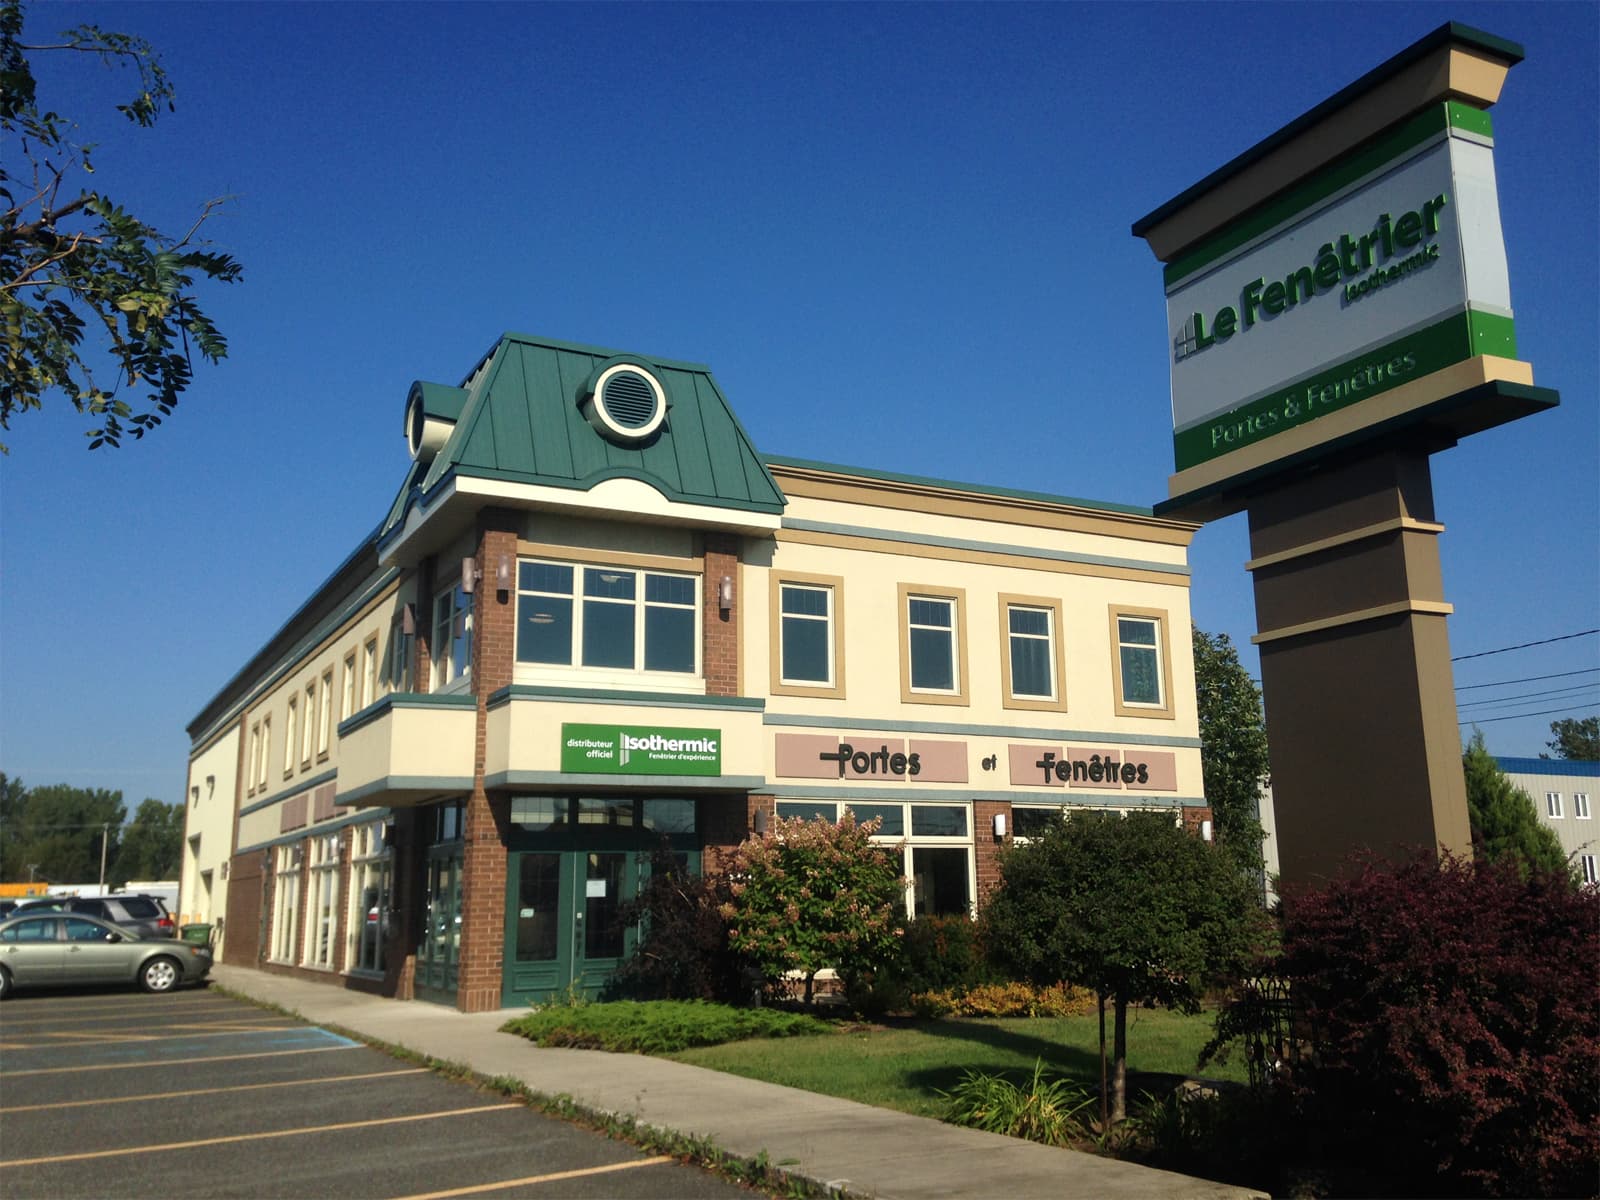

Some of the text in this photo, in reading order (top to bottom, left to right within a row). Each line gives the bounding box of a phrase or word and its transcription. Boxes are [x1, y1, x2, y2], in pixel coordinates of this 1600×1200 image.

[1194, 193, 1447, 343] Le Fenêtrier
[1343, 243, 1441, 304] Isothermic
[1211, 351, 1418, 448] Portes & Fenêtres
[567, 739, 613, 749] distributeur
[586, 751, 613, 759] officiel
[625, 734, 717, 753] Isothermic
[820, 743, 921, 780] Portes
[981, 753, 997, 772] et
